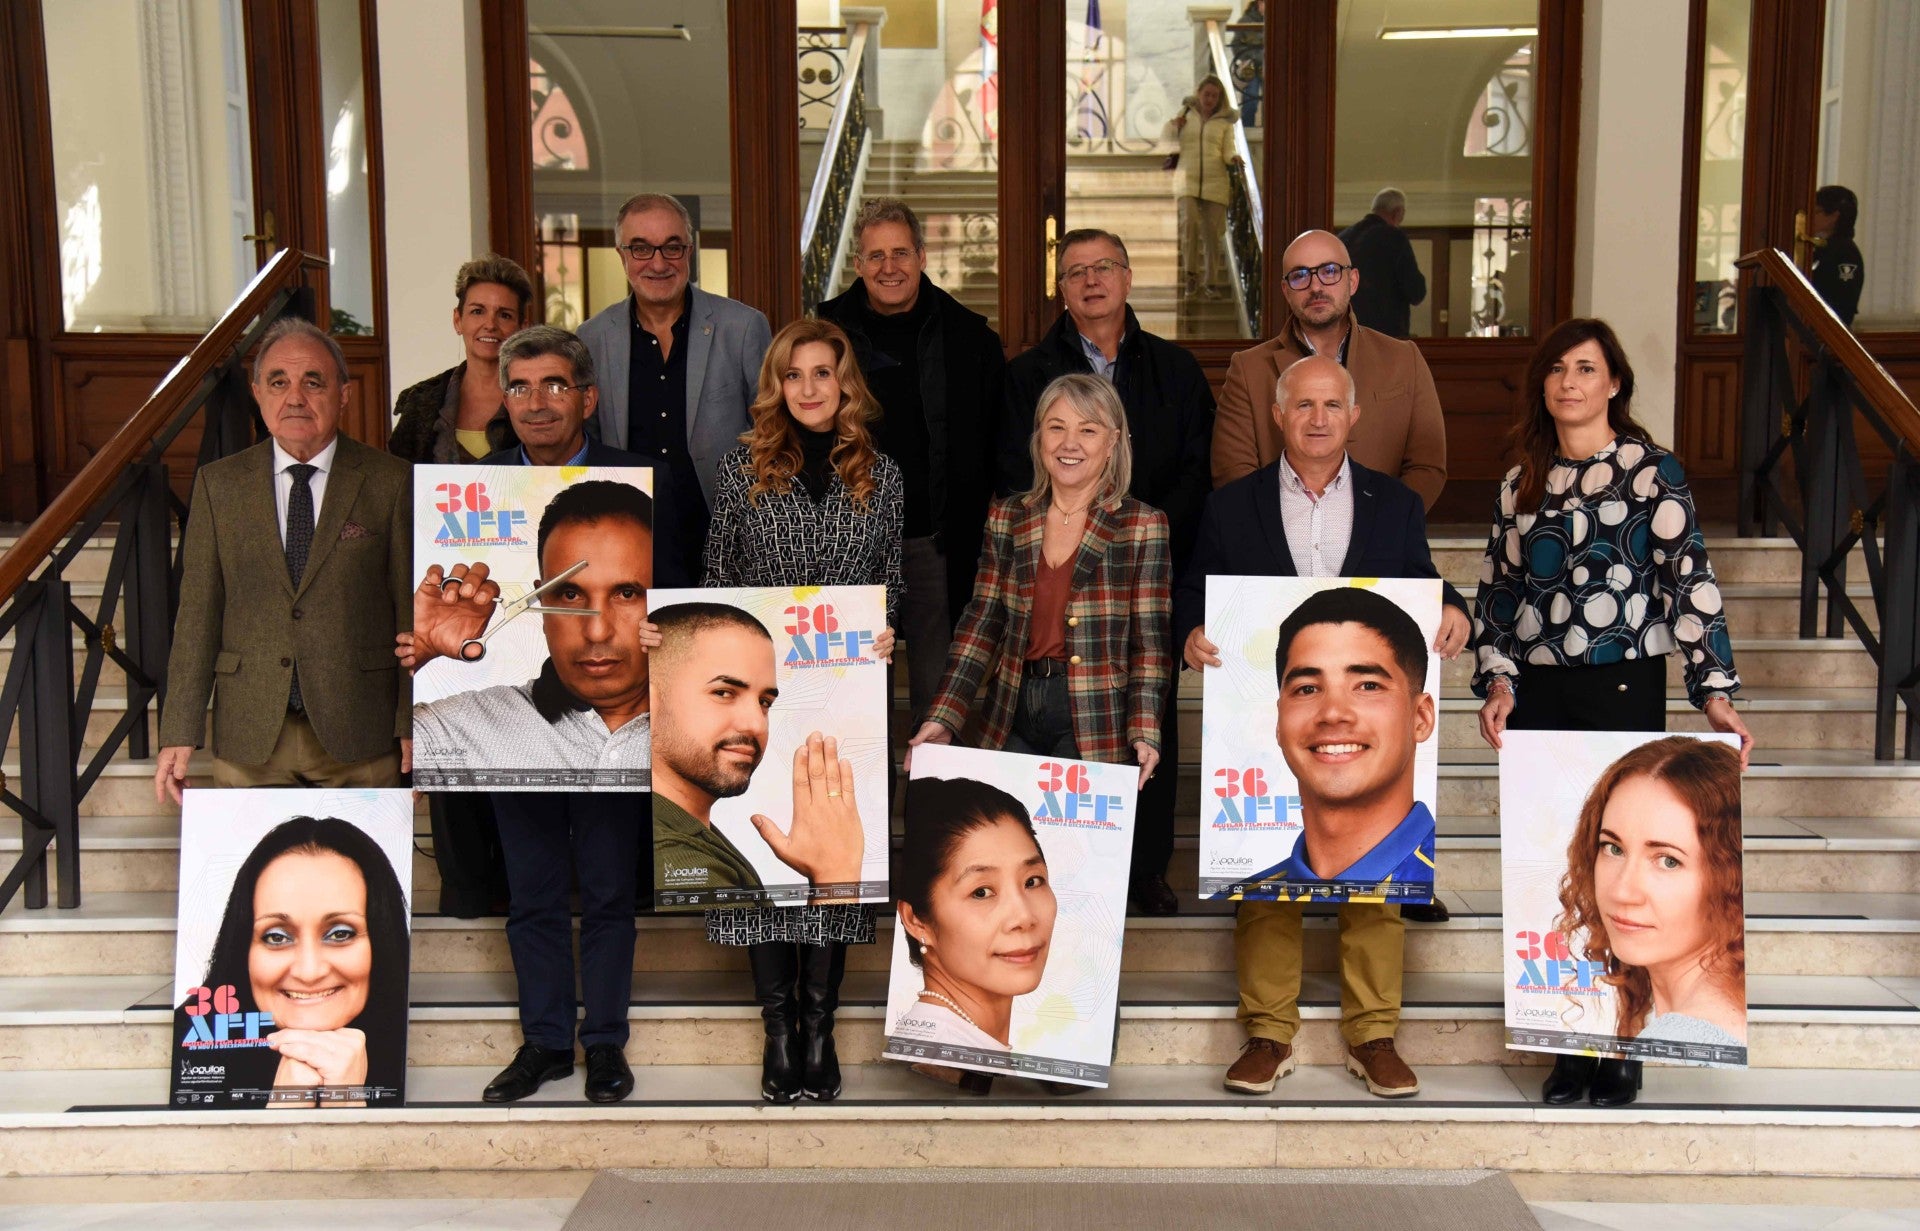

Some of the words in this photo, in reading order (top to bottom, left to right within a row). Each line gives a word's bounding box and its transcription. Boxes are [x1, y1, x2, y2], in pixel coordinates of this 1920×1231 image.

[435, 482, 491, 513] 36
[435, 510, 528, 540] AFF
[784, 604, 839, 635] 36
[785, 630, 875, 662] AFF
[1037, 762, 1091, 794] 36
[1214, 768, 1268, 798] 36
[1035, 791, 1123, 822] AFF
[1212, 796, 1303, 824] AFF
[1515, 930, 1569, 961] 36
[1516, 960, 1607, 988] AFF
[185, 984, 240, 1016] 36
[182, 1012, 276, 1042] AFF
